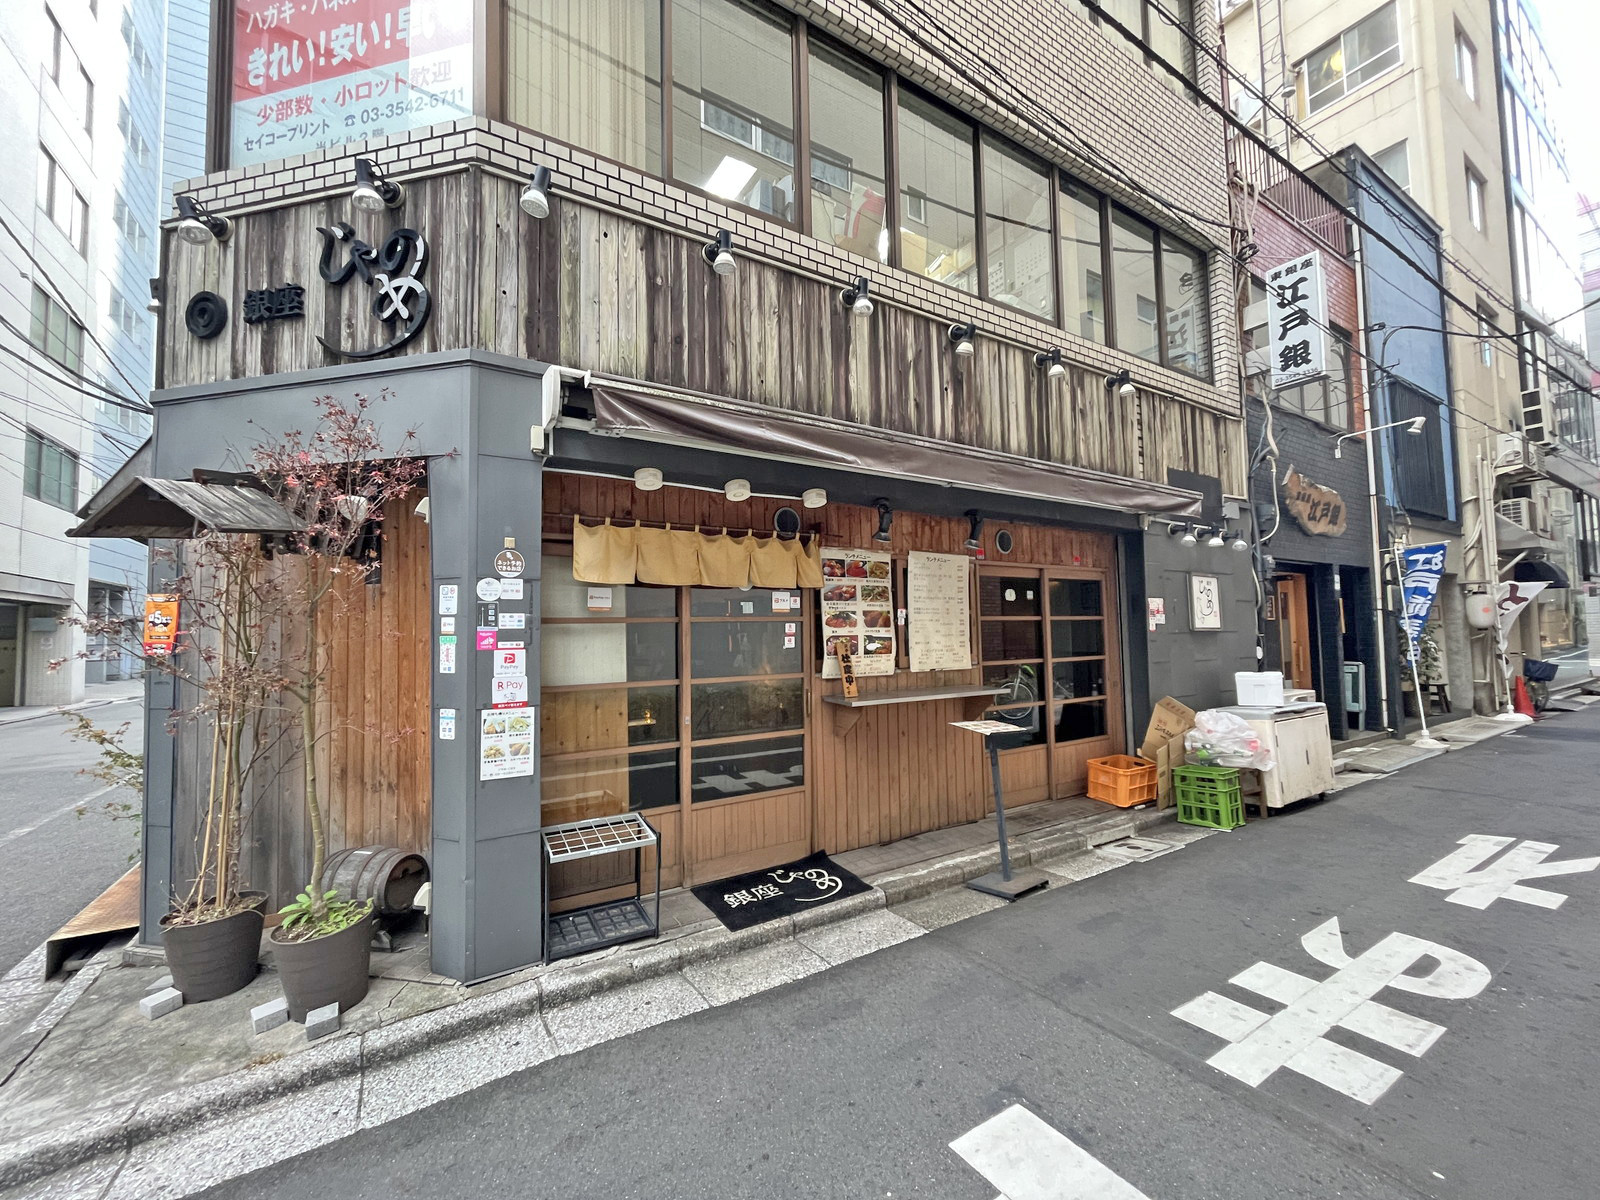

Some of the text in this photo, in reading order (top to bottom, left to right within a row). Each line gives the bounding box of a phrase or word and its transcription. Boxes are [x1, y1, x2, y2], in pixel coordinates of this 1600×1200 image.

[243, 118, 330, 152] セイコープリント
[1270, 257, 1313, 283] 東銀座
[243, 283, 305, 325] 銀座
[1276, 276, 1313, 373] 江戸銀
[497, 681, 524, 690] R Pay
[723, 883, 784, 909] 銀座
